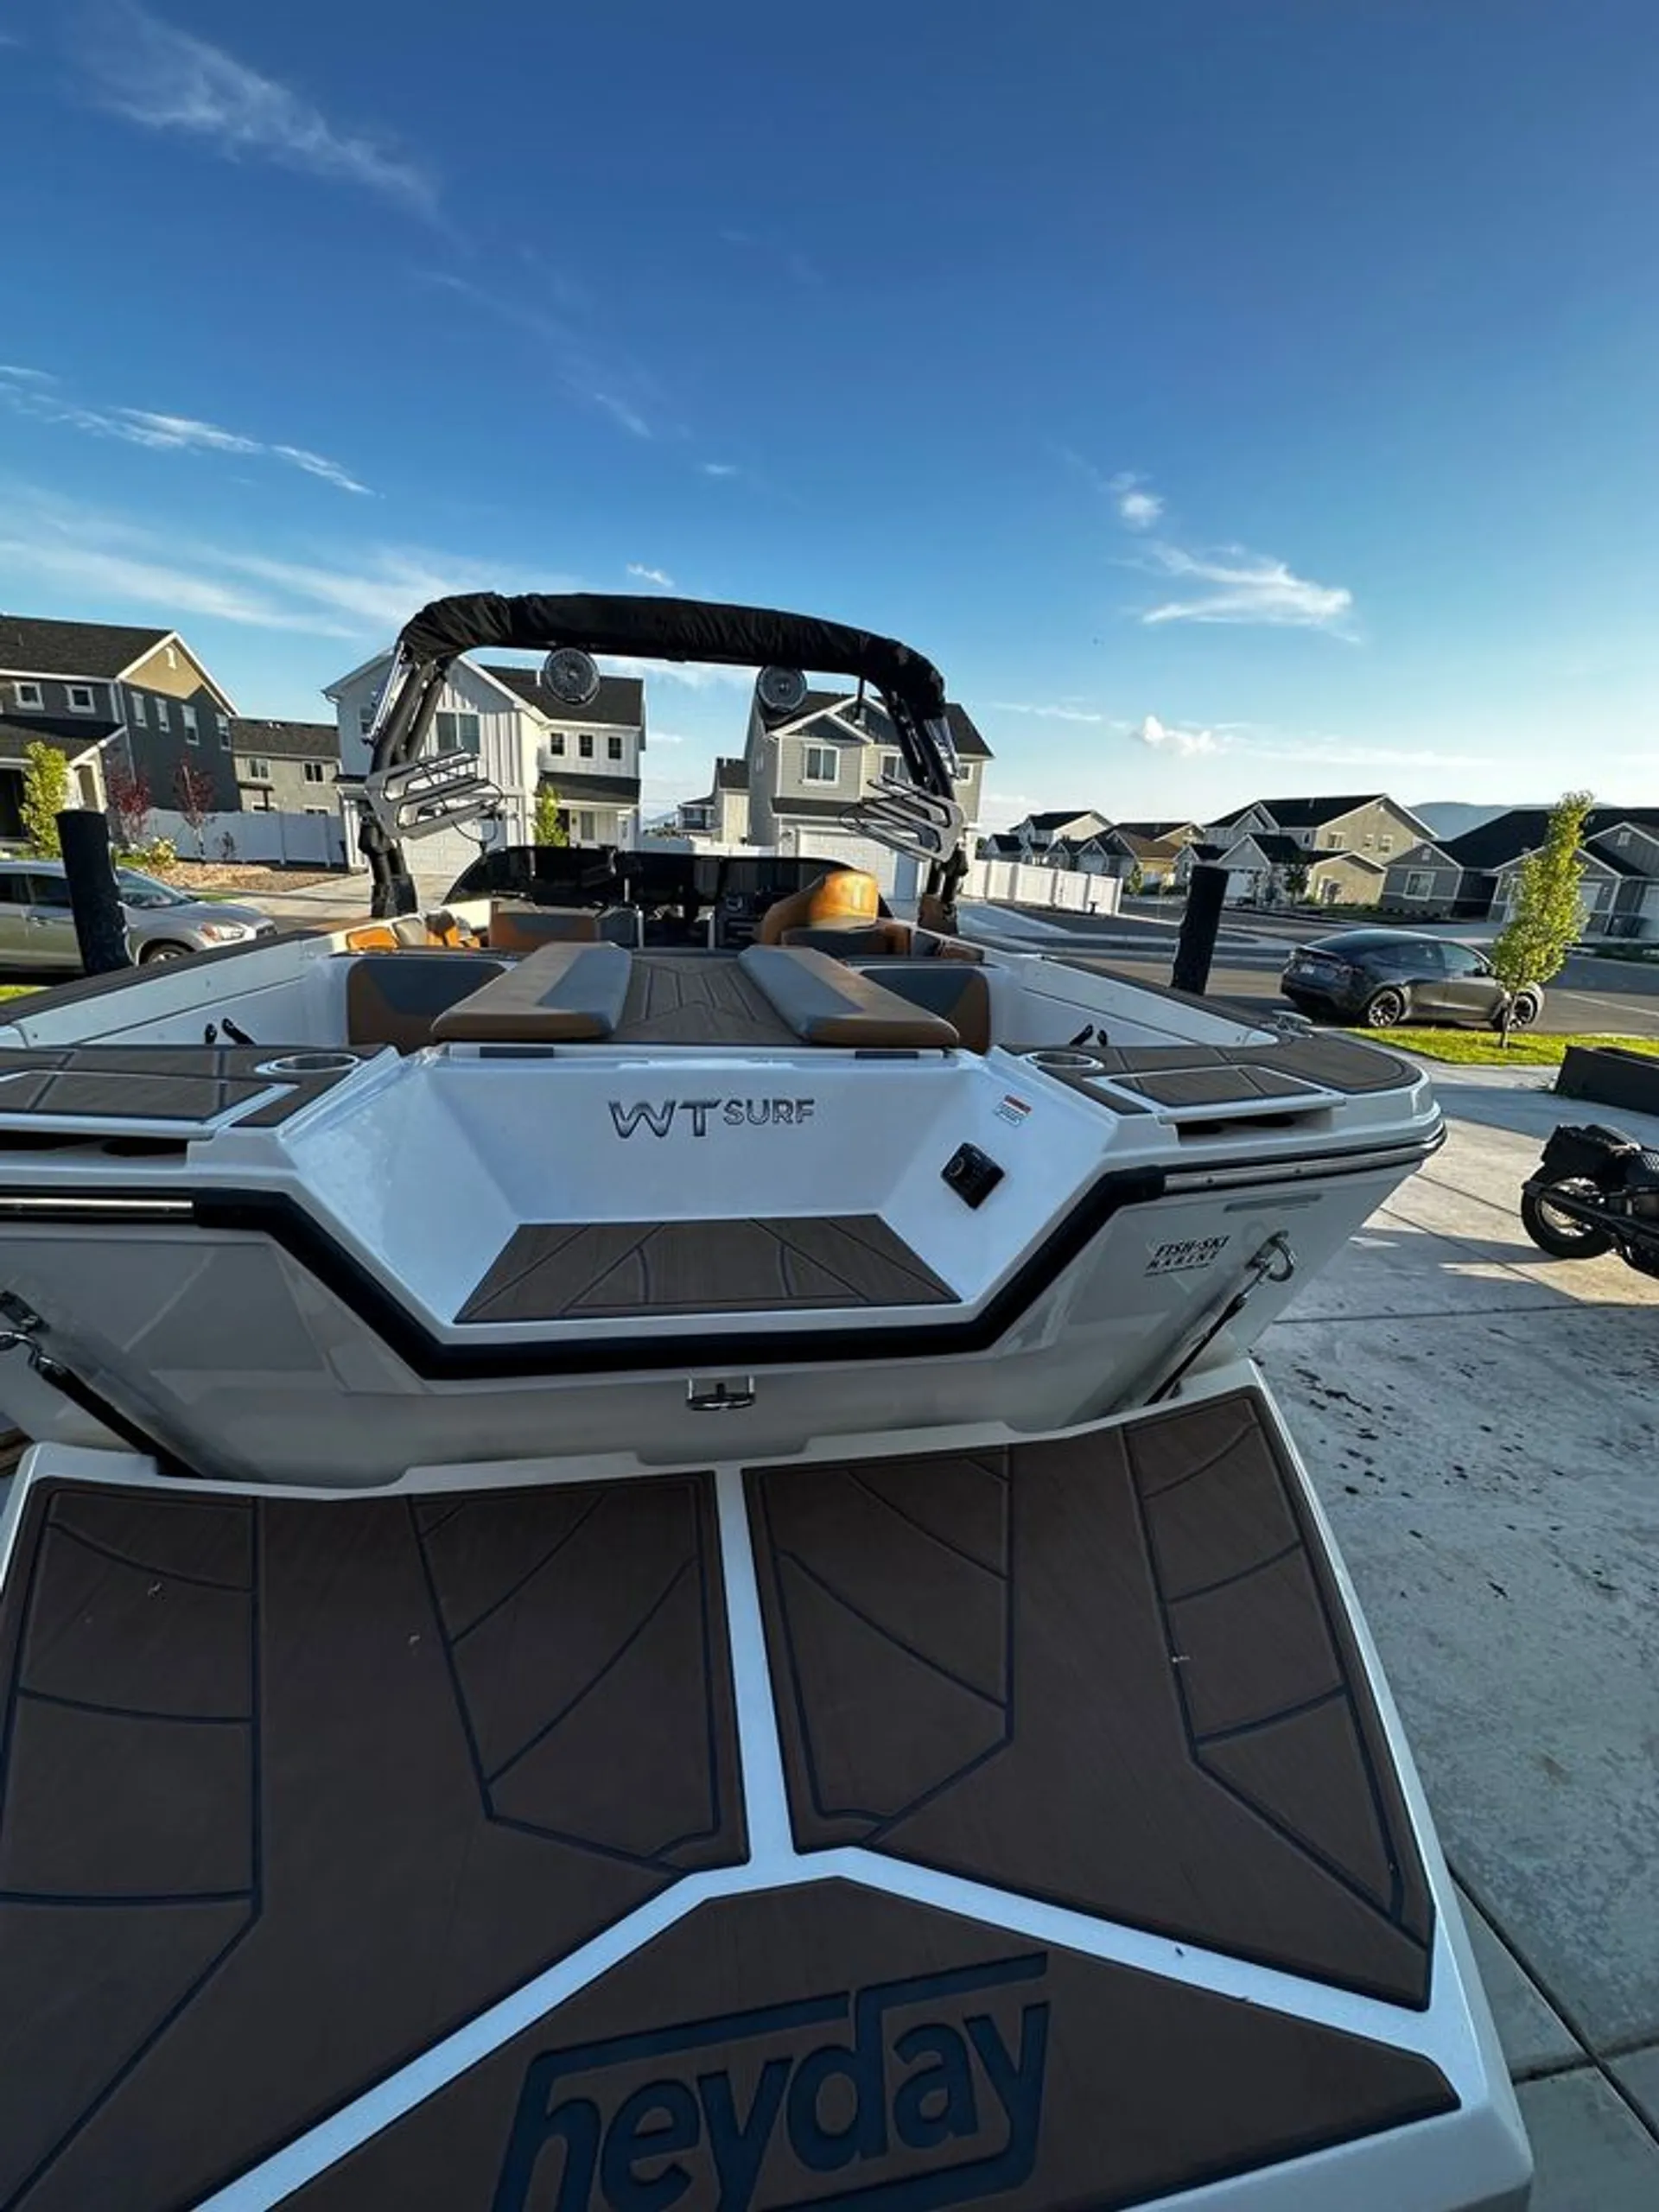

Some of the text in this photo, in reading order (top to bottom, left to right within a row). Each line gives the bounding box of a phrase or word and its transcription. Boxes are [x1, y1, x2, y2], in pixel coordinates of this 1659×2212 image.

[608, 1098, 815, 1138] WT SURF
[491, 1952, 1050, 2211] heyday
